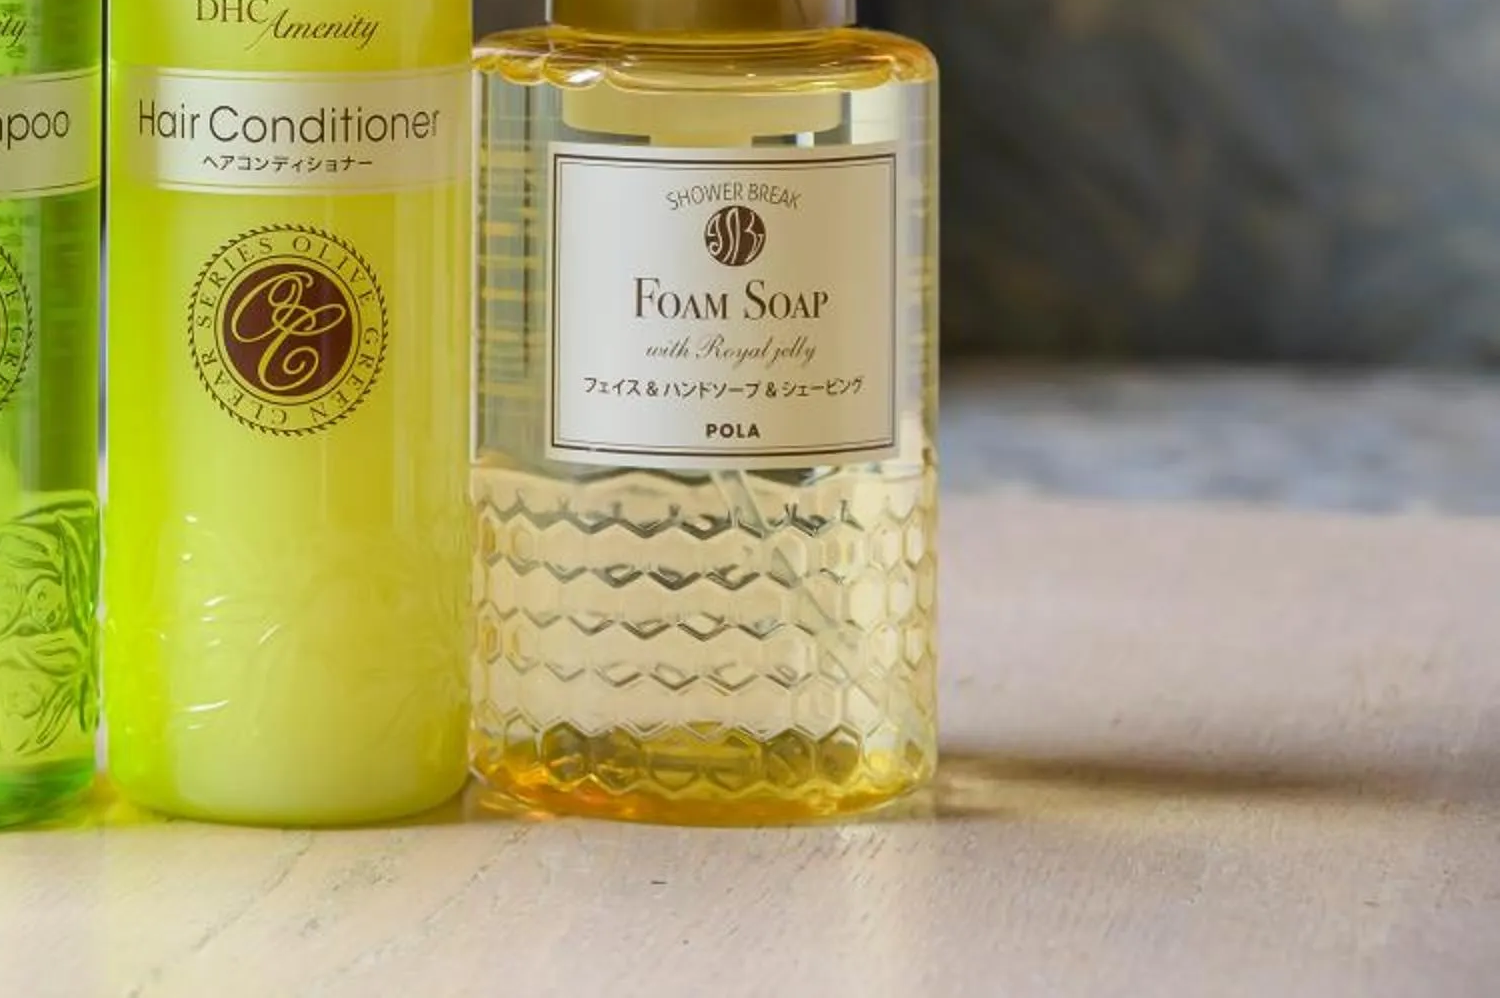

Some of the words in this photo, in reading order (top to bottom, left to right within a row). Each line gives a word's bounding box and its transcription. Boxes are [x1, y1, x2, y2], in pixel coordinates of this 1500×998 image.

[244, 8, 381, 51] Amenity
[138, 99, 201, 139] Hair
[208, 105, 440, 144] Conditioner
[202, 154, 373, 173] ヘアコンディショナー
[666, 182, 744, 211] SHOWER
[748, 182, 802, 210] BREAK
[198, 237, 273, 329] SERIES
[292, 235, 375, 303] OLIVE
[633, 277, 728, 321] FOAM
[743, 278, 829, 321] SOAP
[645, 335, 690, 360] with
[695, 334, 769, 369] Royal
[765, 335, 817, 369] jelly
[201, 348, 287, 425] CLEAR
[310, 327, 379, 423] GREEN
[704, 423, 761, 439] POLA
